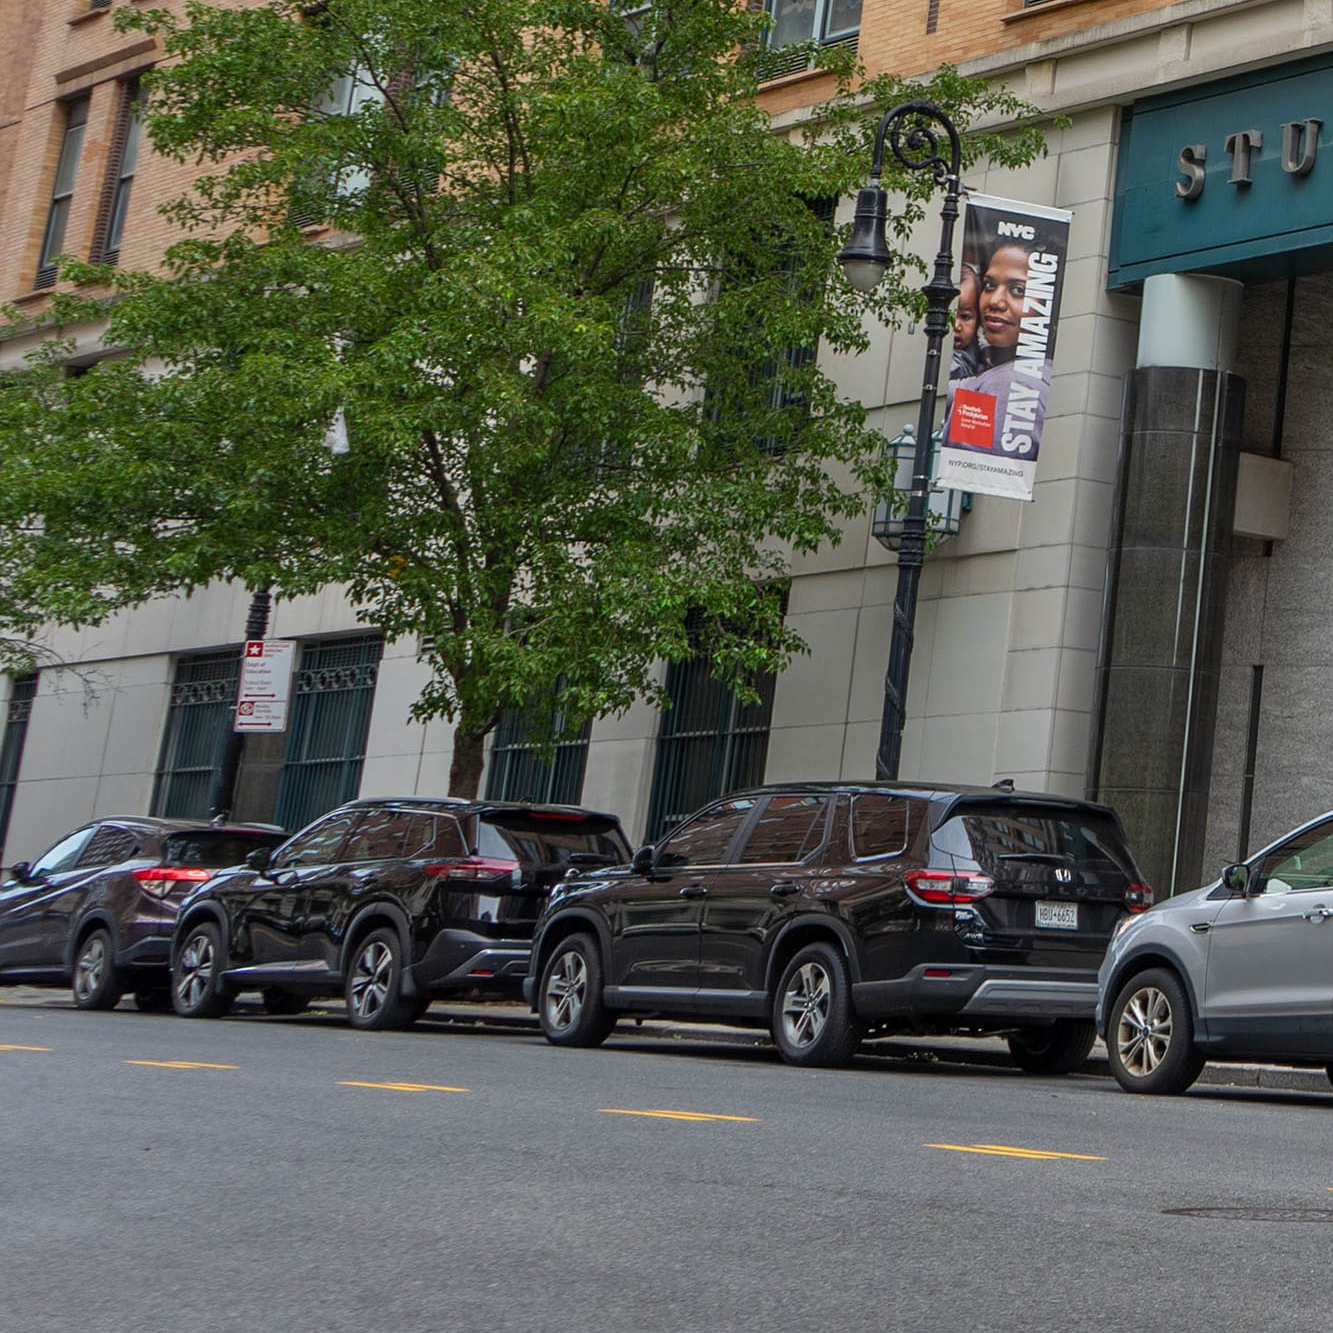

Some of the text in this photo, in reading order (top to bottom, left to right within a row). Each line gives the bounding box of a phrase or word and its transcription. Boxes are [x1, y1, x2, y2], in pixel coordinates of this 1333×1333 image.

[997, 221, 1036, 241] NYC
[1001, 251, 1059, 454] STAY AMAZING
[948, 458, 1024, 478] NYP.ORG/STAYAMAZING
